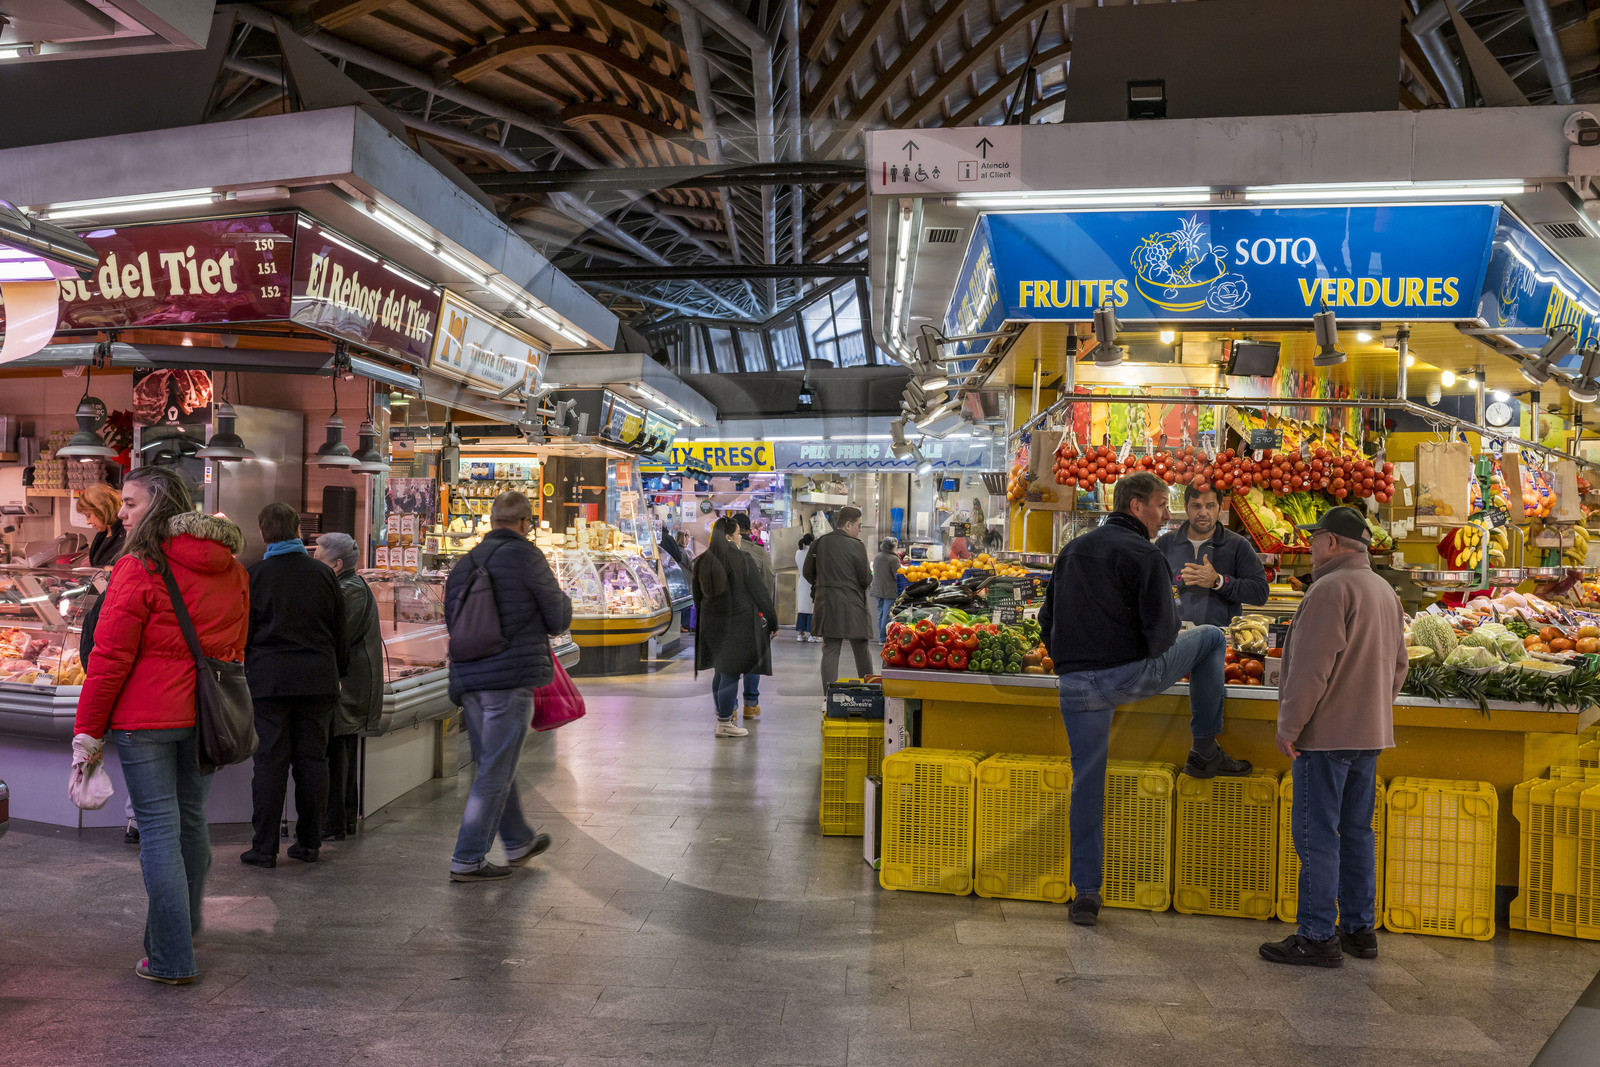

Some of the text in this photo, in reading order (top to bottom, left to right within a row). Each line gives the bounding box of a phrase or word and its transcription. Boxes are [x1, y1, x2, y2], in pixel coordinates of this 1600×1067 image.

[981, 161, 1010, 169] Atenció
[255, 238, 275, 251] 150
[1235, 237, 1317, 265] SOTO
[98, 252, 155, 300] del
[160, 245, 238, 296] Tiet
[258, 262, 278, 275] 151
[261, 286, 281, 299] 152
[306, 253, 431, 344] El Rebost del Tiet
[1018, 276, 1460, 308] FRUITES VERDURES
[703, 446, 767, 467] FRESC
[801, 445, 832, 459] PEIX
[836, 445, 880, 459] FRESC
